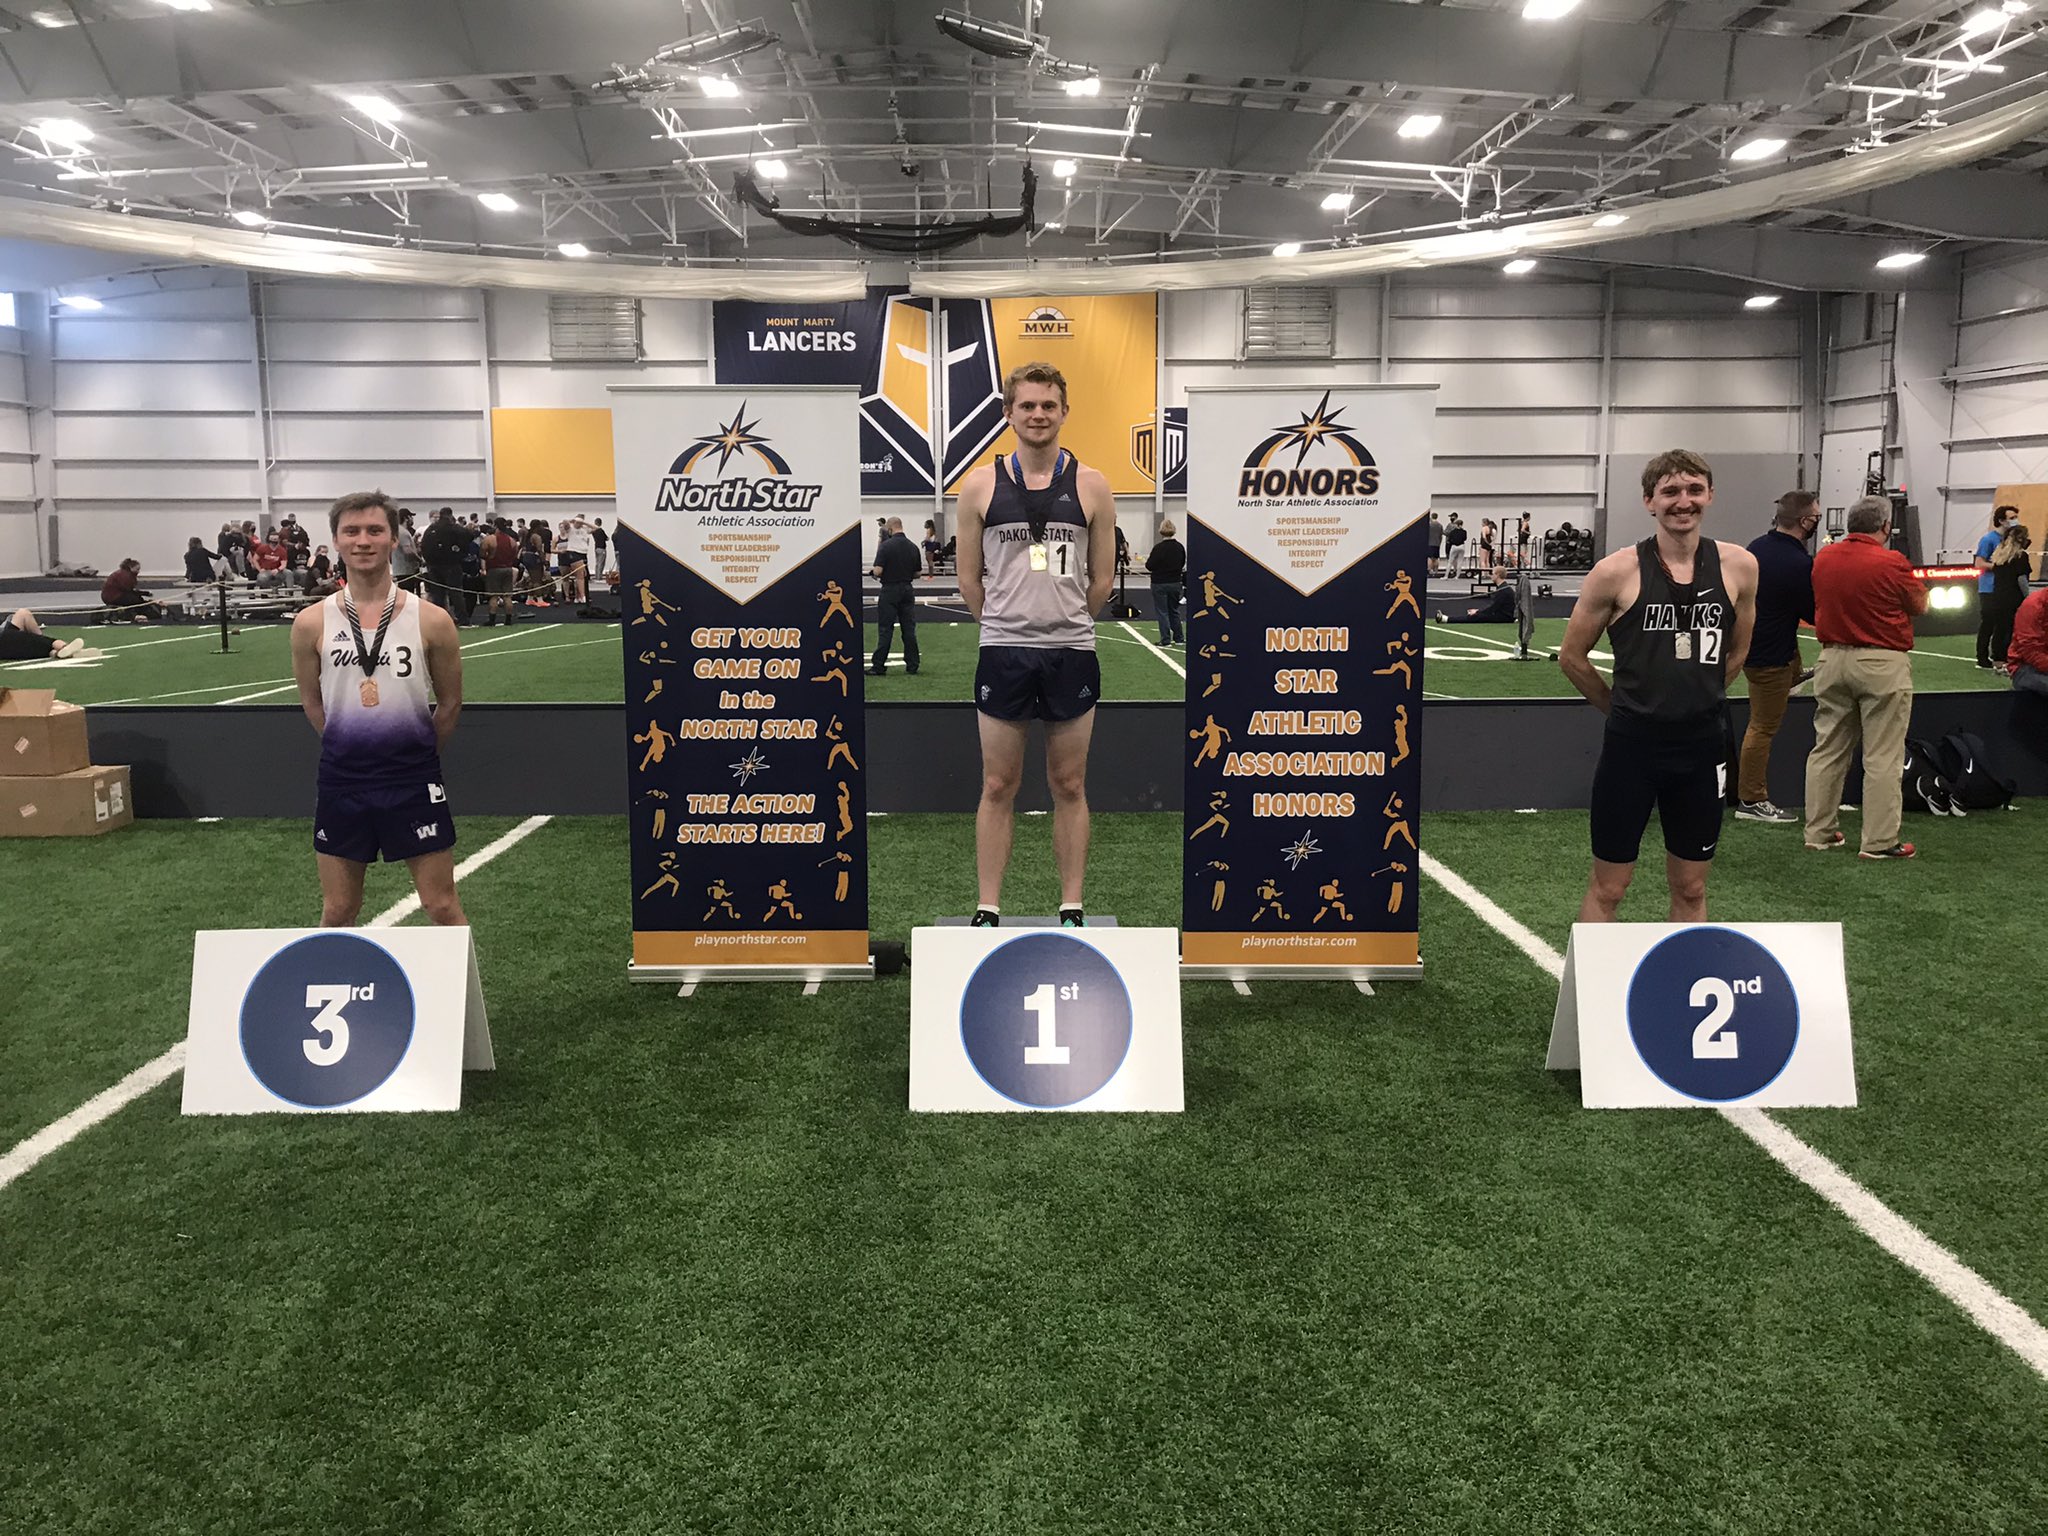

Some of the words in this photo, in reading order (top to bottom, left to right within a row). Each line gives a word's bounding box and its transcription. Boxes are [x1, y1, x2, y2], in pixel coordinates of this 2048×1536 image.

[766, 318, 799, 326] MOUNT
[803, 318, 836, 326] MARTY
[1025, 323, 1068, 333] MWH
[747, 331, 857, 351] LANCERS
[1238, 468, 1381, 497] HONORS
[1237, 499, 1263, 508] North
[1266, 499, 1285, 507] Star
[1286, 498, 1322, 507] Athletic
[1323, 498, 1379, 507] Association
[697, 515, 745, 527] Athletic
[746, 515, 815, 527] Association
[1276, 516, 1342, 526] SPORTSMANSHIP
[708, 533, 772, 542] SPORTSMANSHIP
[999, 528, 1034, 544] DAKOT
[1041, 527, 1074, 542] STATE
[1267, 528, 1301, 536] SERVANT
[1302, 527, 1350, 536] LEADERSHIP
[701, 544, 734, 552] SERVANT
[734, 544, 781, 552] LEADERSHIP
[1277, 539, 1339, 547] RESPONSIBILITY
[710, 555, 771, 563] RESPONSIBILITY
[1056, 544, 1067, 575] 1
[1288, 550, 1328, 558] INTEGRITY
[722, 565, 760, 574] INTEGRITY
[1290, 561, 1325, 569] RESPECT
[725, 576, 758, 584] RESPECT
[1642, 602, 1723, 631] HAKS
[691, 627, 736, 648] GET
[738, 627, 802, 648] YOUR
[1265, 627, 1349, 652] NORTH
[1704, 630, 1718, 662] 2
[396, 646, 412, 678] 3
[693, 658, 762, 679] GAME
[764, 658, 801, 679] ON
[1274, 669, 1338, 694] STAR
[719, 690, 740, 709] in
[742, 690, 776, 709] the
[680, 719, 758, 740] NORTH
[760, 719, 818, 740] STAR
[1247, 710, 1362, 735] ATHLETIC
[1223, 752, 1386, 777] ASSOCIATION
[687, 793, 730, 814] THE
[731, 793, 816, 814] ACTION
[1252, 793, 1356, 817] HONORS
[677, 823, 758, 844] STARTS
[760, 823, 825, 844] HERE!
[694, 933, 807, 947] playnorthstar.com
[1241, 935, 1358, 949] playnorthstar.com
